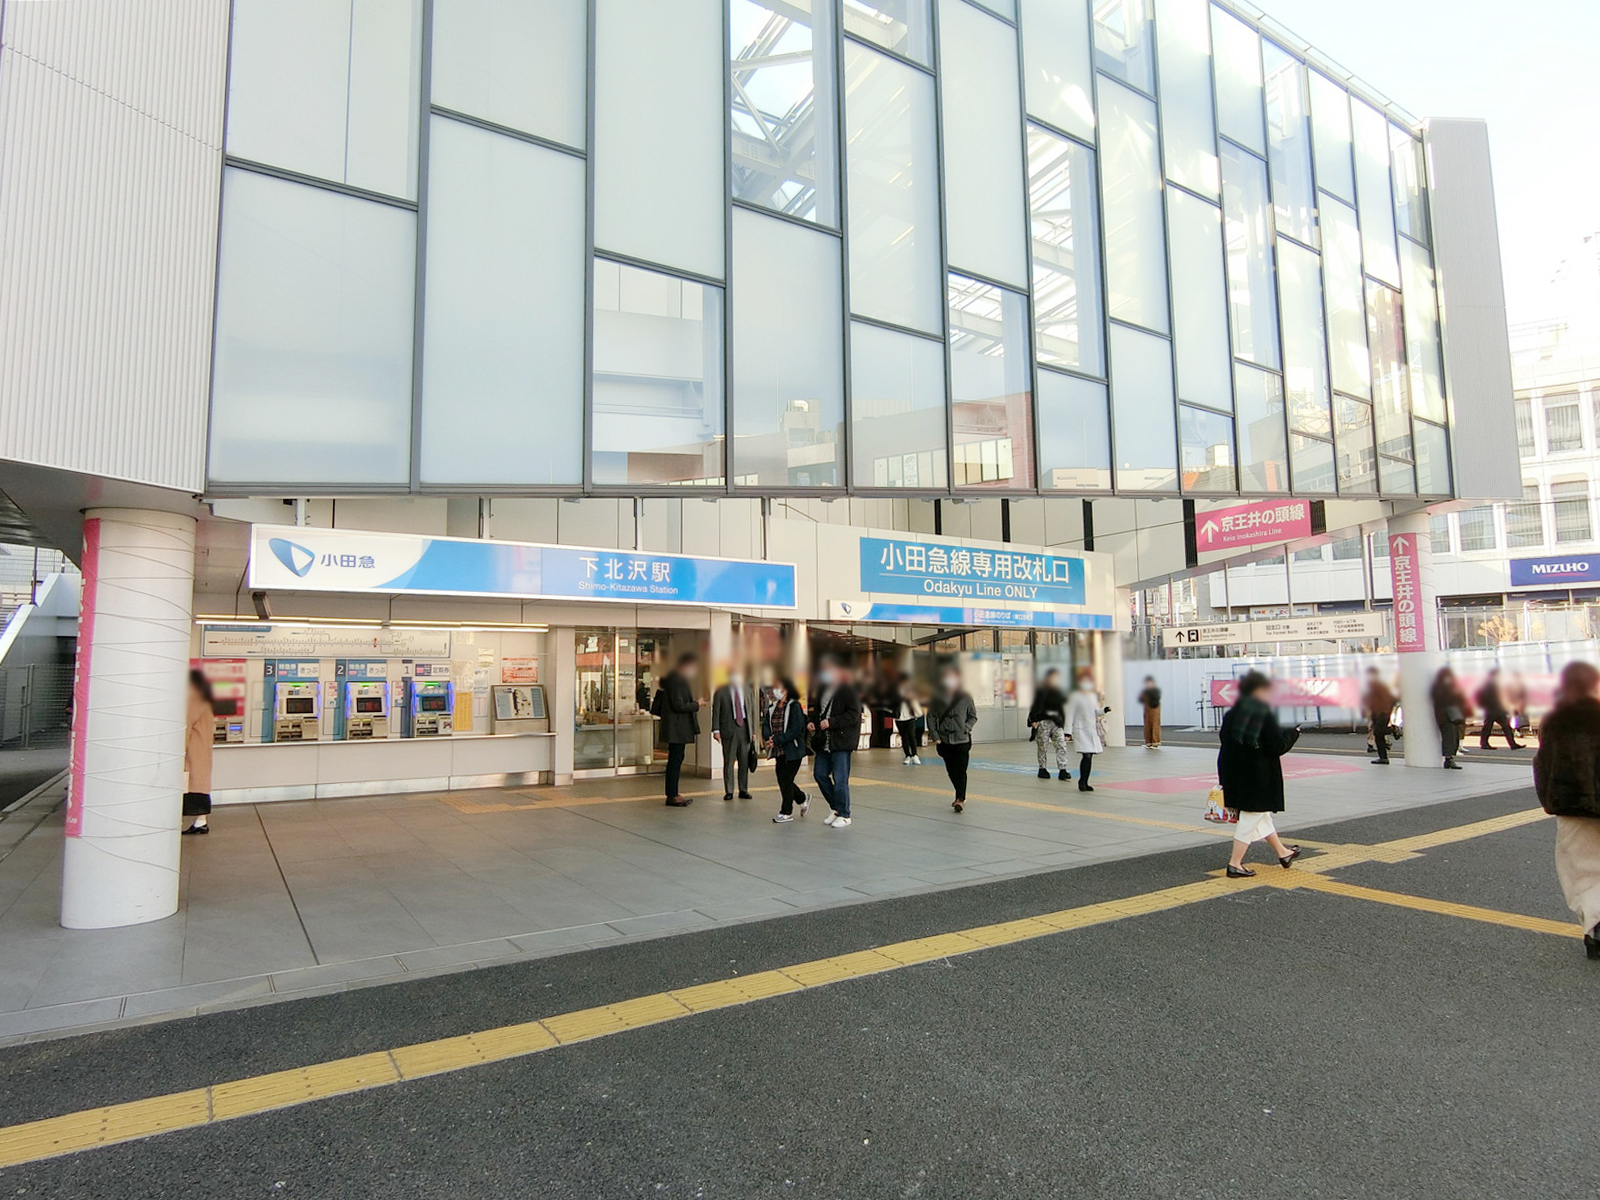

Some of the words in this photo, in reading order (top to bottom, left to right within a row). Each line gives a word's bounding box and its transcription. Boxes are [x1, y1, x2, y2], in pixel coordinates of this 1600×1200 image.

[1221, 502, 1305, 533] 京王井の頭線
[1222, 535, 1235, 543] Keio
[1236, 530, 1268, 541] Inokashira
[1268, 527, 1282, 536] Line
[320, 553, 376, 570] 小田急
[578, 556, 671, 583] 下北沢駅
[880, 542, 1070, 584] 小田急線専用改札口
[1531, 561, 1590, 575] MIZUHO
[578, 581, 648, 594] Shimo-Kitazawa
[649, 584, 679, 595] Station
[923, 578, 973, 599] Odakyu
[975, 581, 1002, 598] Line
[1004, 584, 1038, 600] ONLY
[1393, 555, 1418, 643] 京王井の頭線
[266, 665, 274, 675] 3
[336, 665, 344, 675] 2
[404, 666, 410, 675] 1
